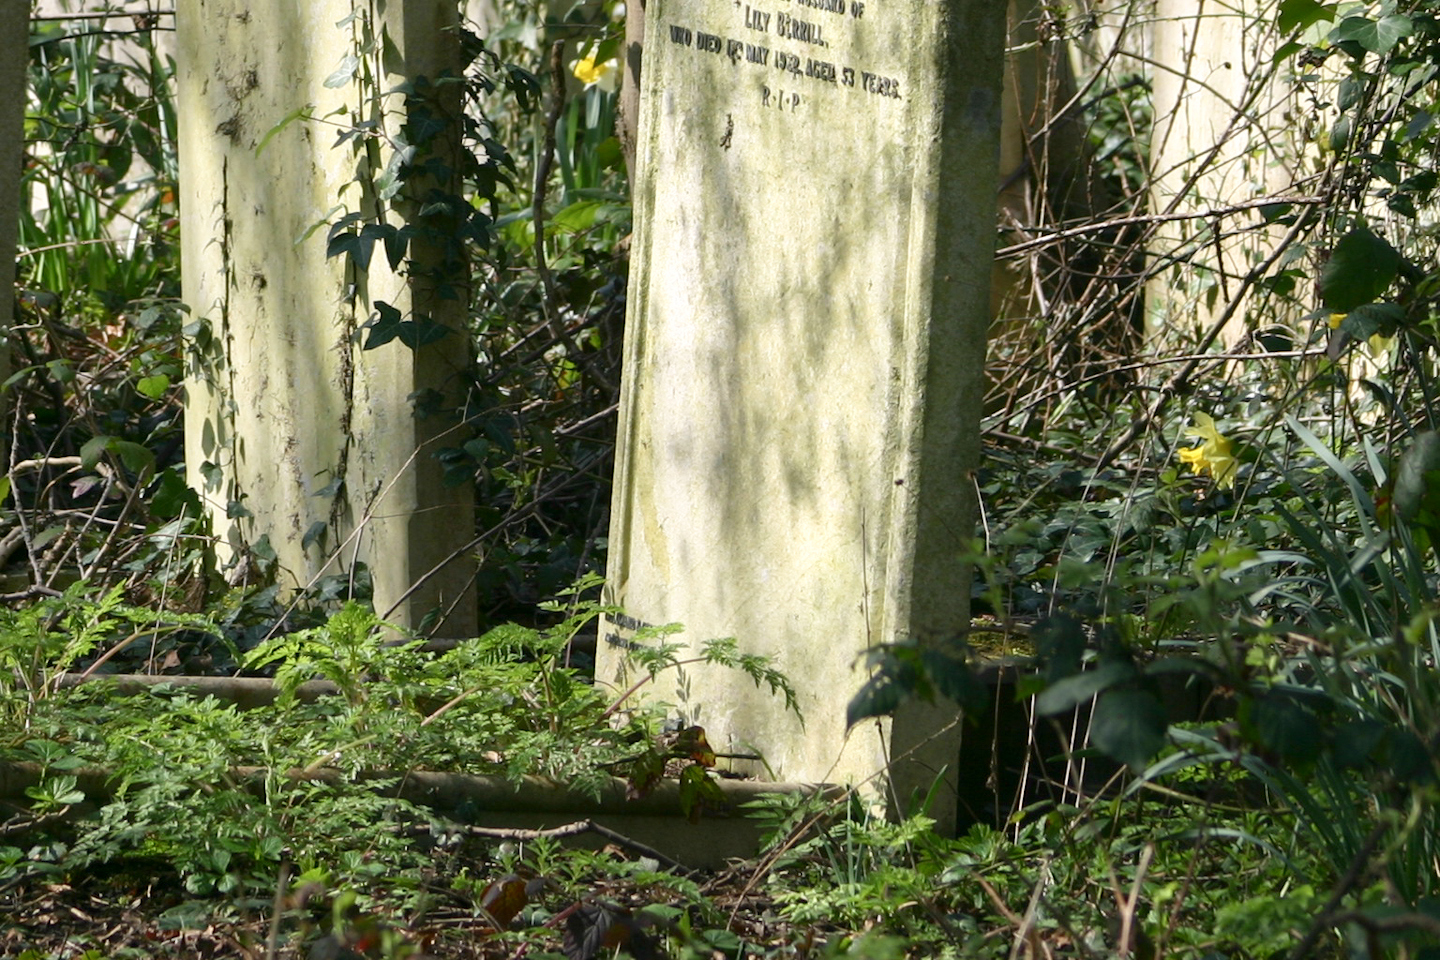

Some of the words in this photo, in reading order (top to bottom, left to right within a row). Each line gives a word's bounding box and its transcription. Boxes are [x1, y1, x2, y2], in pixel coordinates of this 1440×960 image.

[744, 4, 771, 33] LILY
[850, 0, 865, 19] OF
[669, 23, 692, 47] WHO
[696, 30, 721, 54] DIED
[745, 43, 770, 67] MAY
[805, 57, 836, 82] AGED
[841, 66, 855, 87] 53
